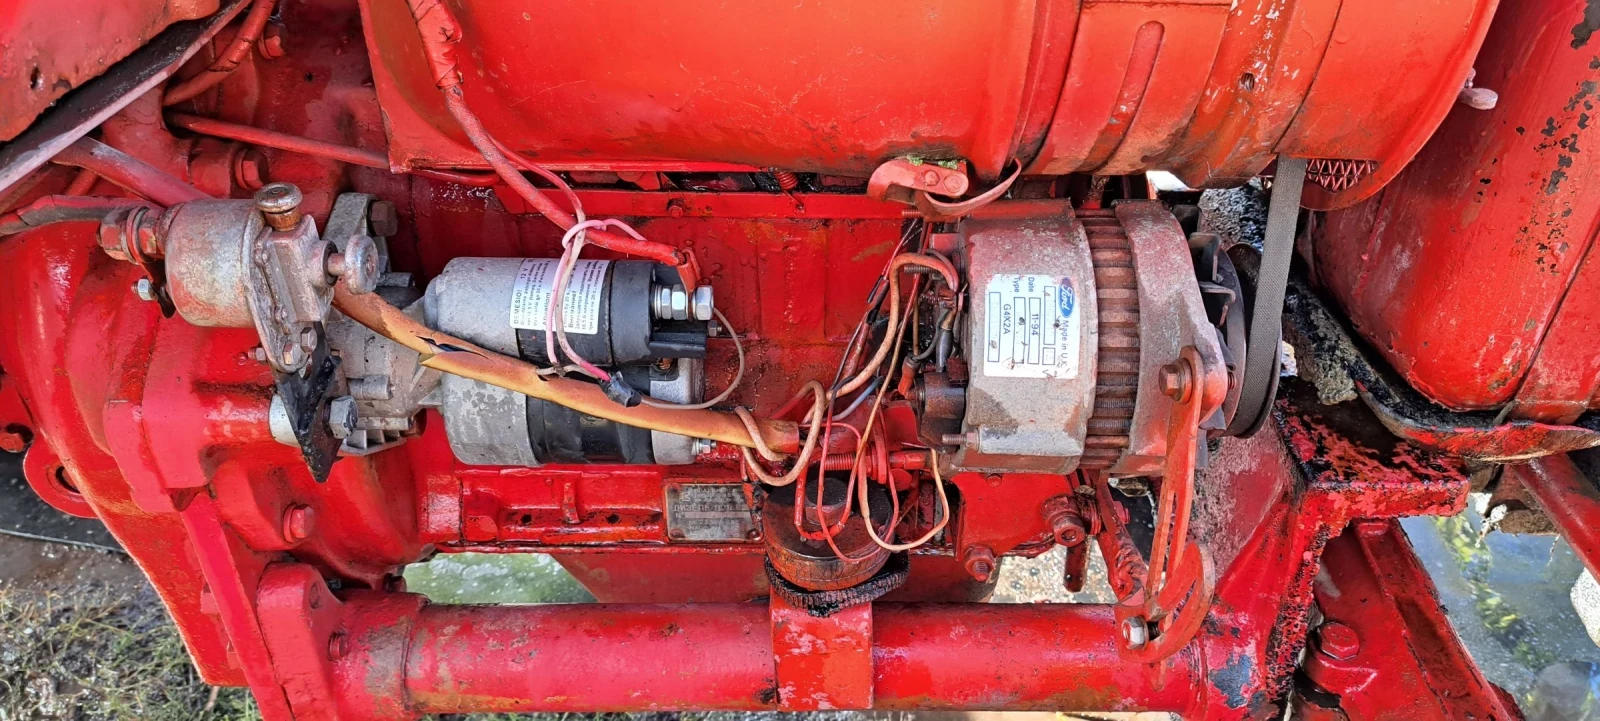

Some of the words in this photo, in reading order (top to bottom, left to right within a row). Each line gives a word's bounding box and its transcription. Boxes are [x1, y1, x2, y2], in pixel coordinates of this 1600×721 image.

[1012, 277, 1020, 293] Type
[1003, 303, 1011, 335] G4X2A
[1030, 313, 1039, 336] 11-94
[1061, 320, 1069, 342] Made
